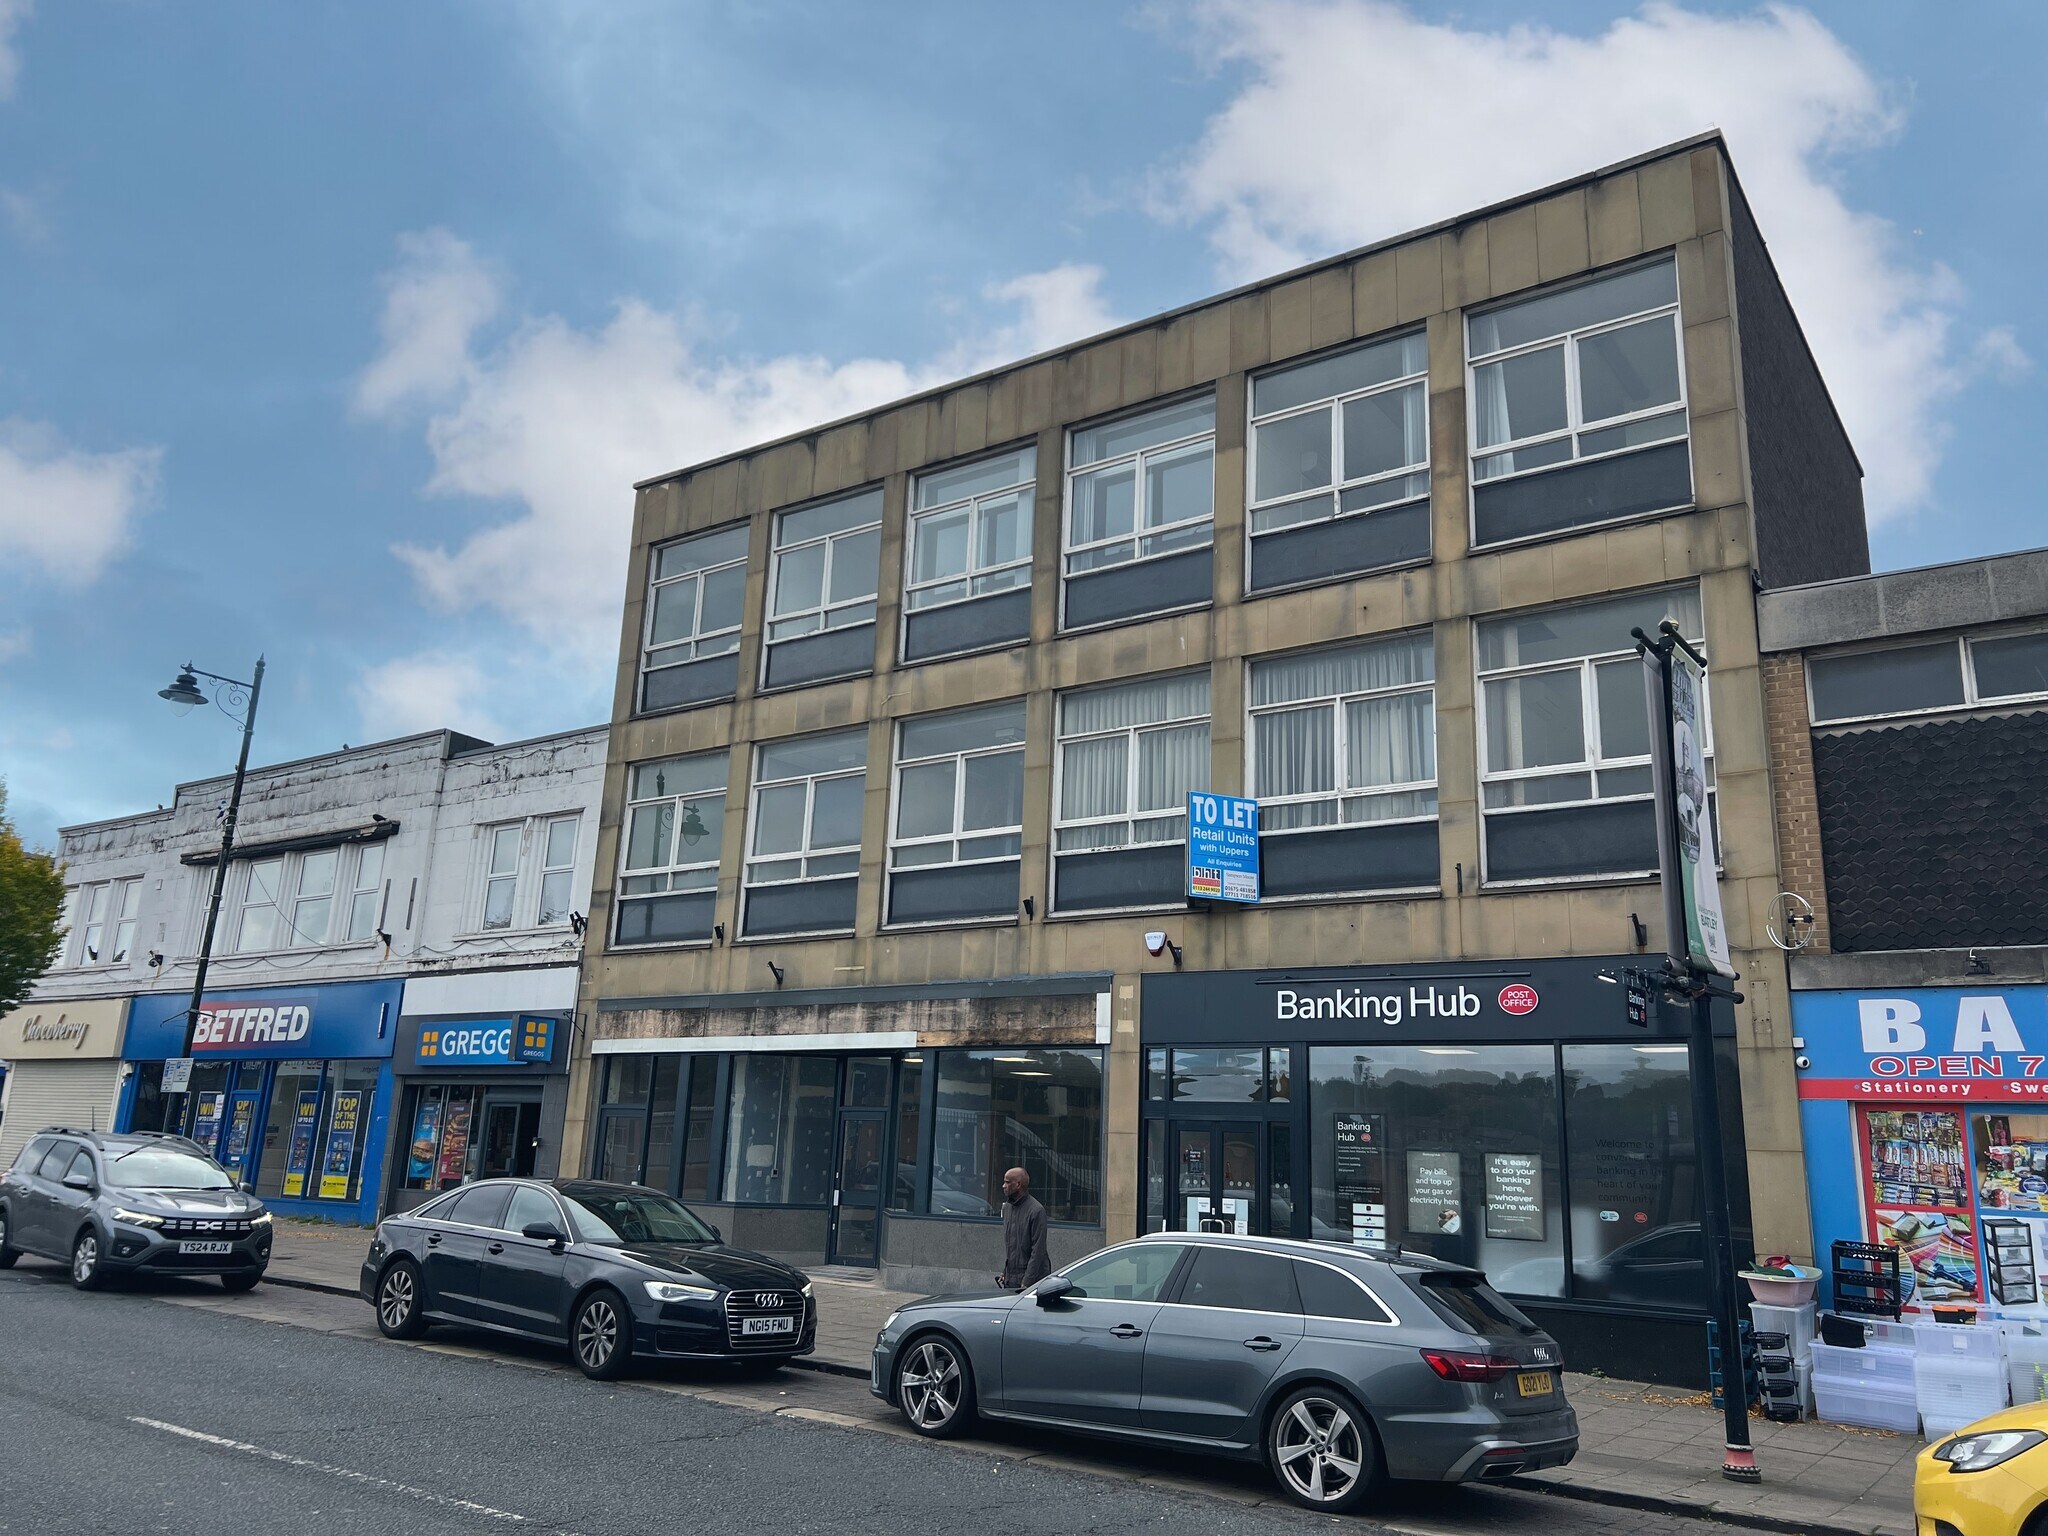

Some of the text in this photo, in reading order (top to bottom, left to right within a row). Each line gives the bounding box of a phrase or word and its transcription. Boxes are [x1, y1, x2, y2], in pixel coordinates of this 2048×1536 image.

[1192, 795, 1256, 829] TO LET
[1192, 826, 1256, 846] Retail Units
[1199, 843, 1250, 857] with Uppers
[1215, 859, 1242, 868] Enquiries
[1507, 990, 1530, 1000] POST
[1628, 990, 1645, 1009] Banking
[1277, 985, 1481, 1025] Banking Hub
[1502, 998, 1534, 1008] OFFICE
[1629, 1006, 1639, 1021] Hub
[192, 1005, 310, 1044] BETFRED
[1858, 995, 2026, 1053] BA
[22, 1013, 90, 1050] Chocoberry
[523, 1049, 545, 1058] GREGGS
[1870, 1055, 2045, 1077] OPEN 7
[1861, 1081, 2048, 1096] Stationery Swe
[337, 1097, 358, 1111] TOP
[335, 1111, 356, 1120] OF THE
[333, 1120, 354, 1130] SLOTS
[1337, 1121, 1371, 1132] Banking
[1337, 1133, 1355, 1141] Hub
[1595, 1139, 1655, 1149] Welcome to
[1494, 1158, 1531, 1168] It's easy
[1419, 1167, 1447, 1176] Pay bills
[1596, 1165, 1636, 1177] banking
[1638, 1167, 1648, 1175] in
[1430, 1178, 1441, 1186] top
[1496, 1175, 1531, 1186] banking
[1597, 1180, 1664, 1191] heart of your
[1502, 1184, 1525, 1194] here,
[1409, 1196, 1459, 1206] electricity here
[1494, 1194, 1533, 1203] whoever
[1598, 1193, 1654, 1205] community
[1488, 1203, 1540, 1212] you're with.
[184, 1242, 229, 1252] YS24 RJX
[749, 1320, 770, 1332] NG15
